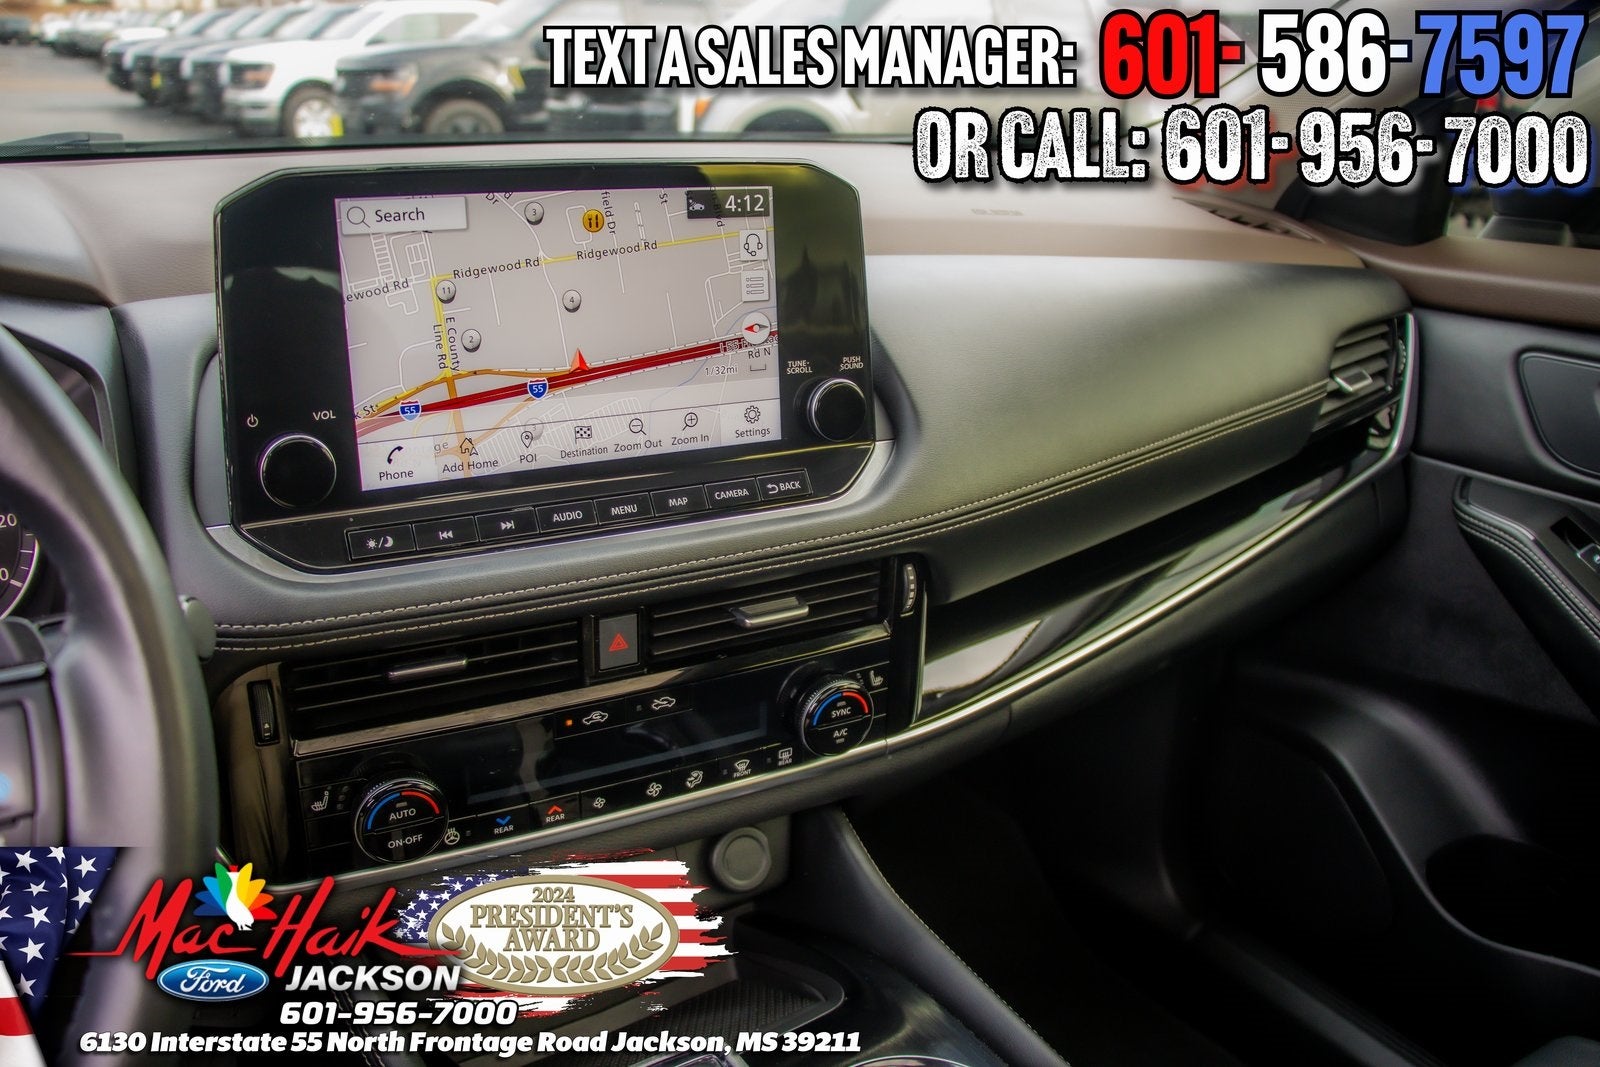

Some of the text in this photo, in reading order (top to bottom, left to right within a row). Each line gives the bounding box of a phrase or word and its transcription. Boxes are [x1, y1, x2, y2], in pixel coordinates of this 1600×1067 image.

[725, 194, 764, 212] 4:12
[375, 207, 425, 222] Search
[607, 221, 616, 236] Dr
[577, 240, 658, 260] Ridgewood Rd
[453, 256, 540, 279] Ridgewood Rd
[393, 278, 409, 290] Rd
[433, 324, 449, 370] Line Rd
[447, 328, 460, 372] County
[748, 347, 771, 359] Rd N
[842, 356, 861, 364] PUSH
[705, 365, 738, 376] 1/32mi
[786, 367, 813, 375] SCROLL
[840, 363, 864, 371] SOUND
[532, 384, 544, 394] 55
[313, 410, 336, 420] VOL
[404, 406, 417, 415] 55
[735, 425, 771, 439] Settings
[614, 438, 663, 453] Zoom Out
[671, 433, 710, 446] Zoom In
[560, 444, 609, 459] Destination
[520, 453, 537, 464] POI
[442, 458, 499, 474] Add Home
[379, 470, 414, 481] Phone
[780, 481, 801, 491] BACK
[715, 487, 750, 500] CAMERA
[668, 496, 688, 507] MAP
[611, 503, 638, 516] MENU
[553, 510, 583, 523] AUDIO
[831, 707, 852, 718] SYNC
[833, 728, 848, 738] A/C
[389, 808, 416, 820] AUTO
[546, 813, 566, 823] REAR
[494, 824, 514, 835] REAR
